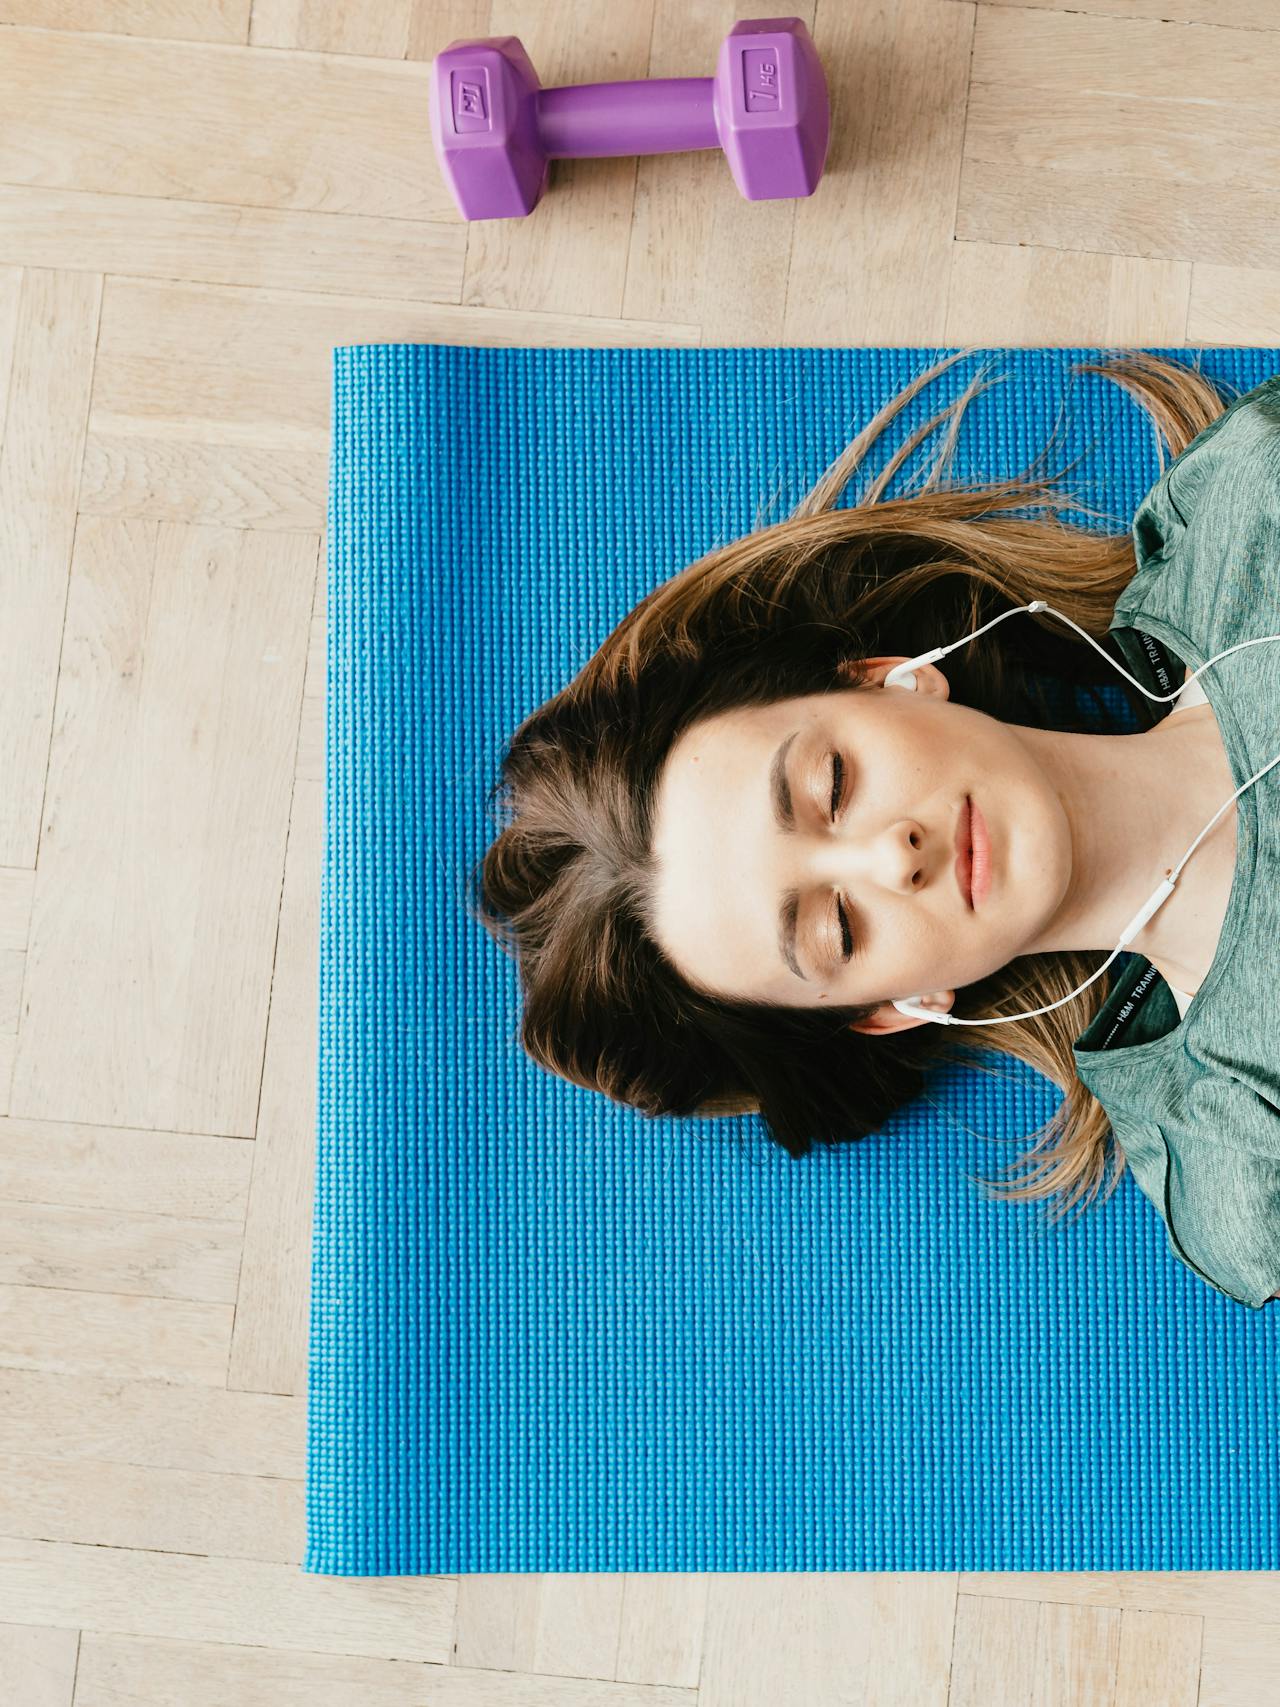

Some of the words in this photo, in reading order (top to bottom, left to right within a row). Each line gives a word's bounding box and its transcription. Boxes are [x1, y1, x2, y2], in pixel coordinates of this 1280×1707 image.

[1140, 631, 1161, 665] TRAIN
[1156, 667, 1171, 690] H&M
[1117, 1001, 1135, 1022] H&M
